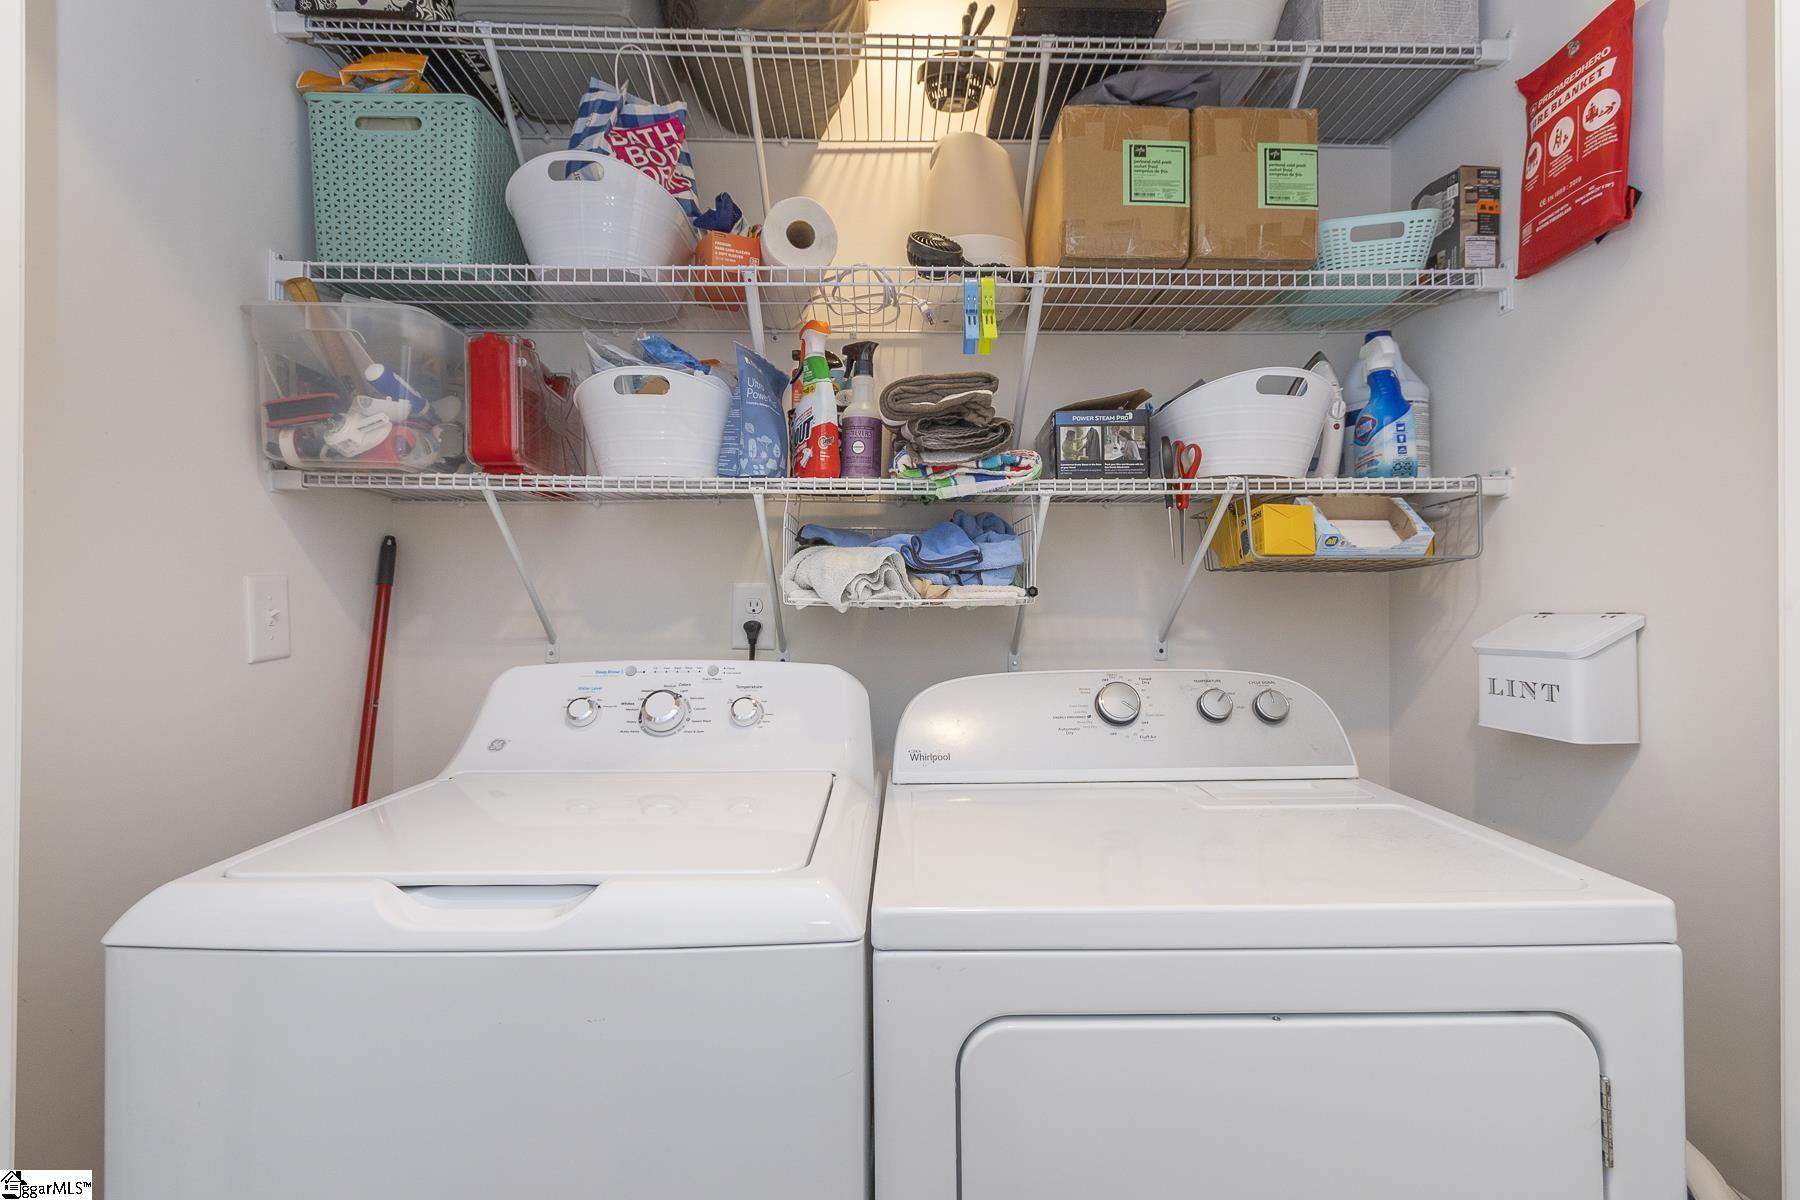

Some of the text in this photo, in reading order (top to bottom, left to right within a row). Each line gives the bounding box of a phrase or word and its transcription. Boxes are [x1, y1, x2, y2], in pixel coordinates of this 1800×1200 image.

[1550, 65, 1605, 112] BLANKET
[609, 122, 679, 148] BATH
[625, 142, 682, 167] BOD
[1487, 677, 1560, 703] LINT
[909, 752, 951, 763] Whirlpool
